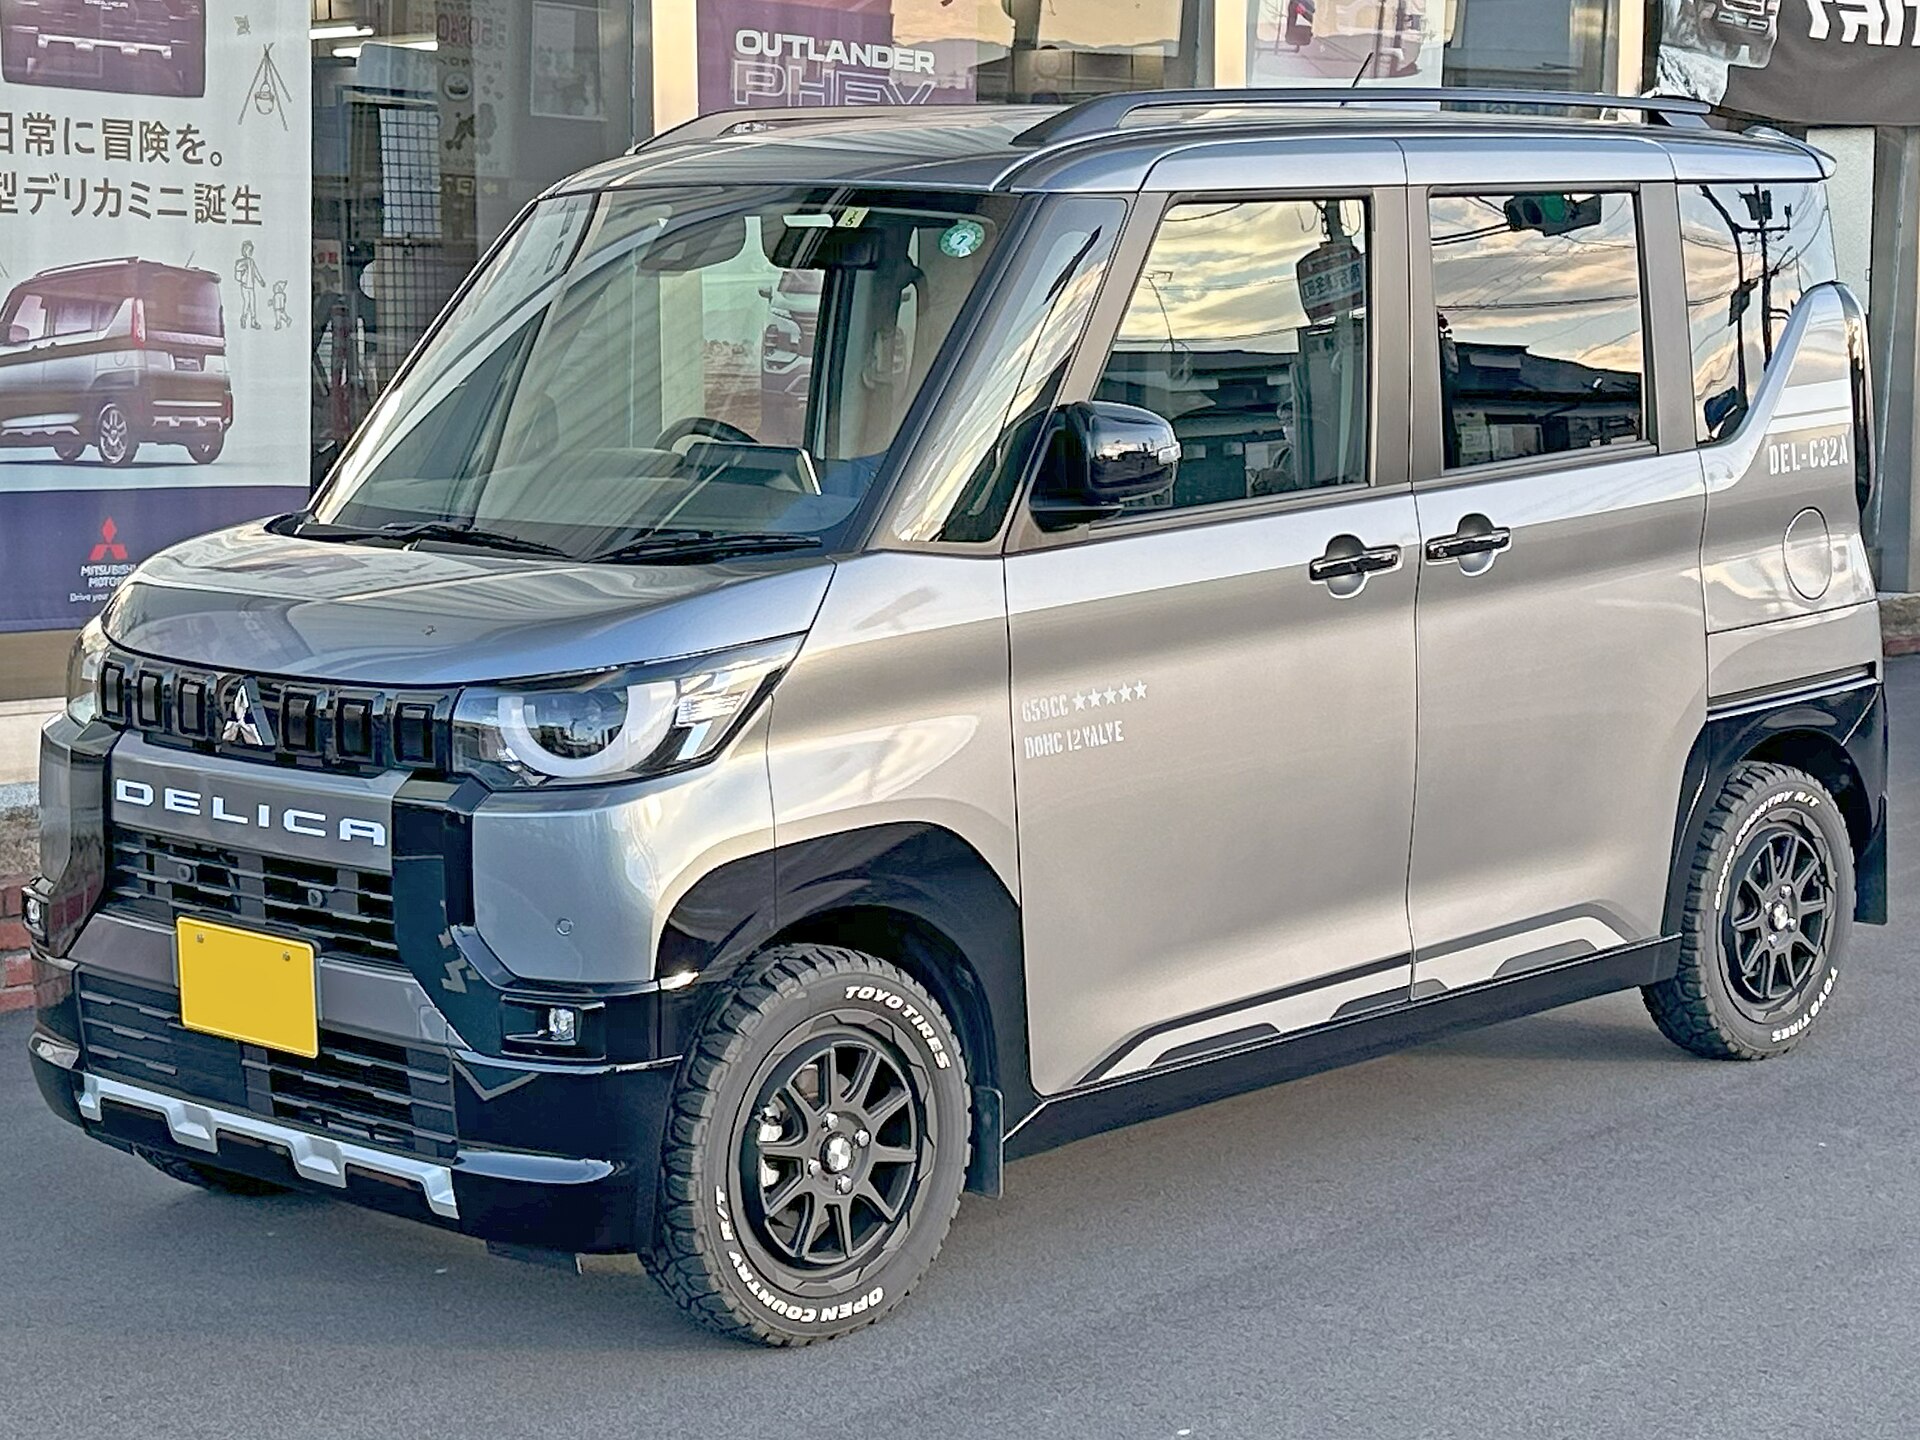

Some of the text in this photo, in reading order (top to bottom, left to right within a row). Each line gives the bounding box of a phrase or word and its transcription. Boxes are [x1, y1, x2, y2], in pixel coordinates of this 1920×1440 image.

[733, 59, 937, 105] PHEV
[735, 29, 935, 74] OUTLANDER
[115, 778, 386, 847] DELICA
[845, 986, 951, 1069] TOYO TIRES
[715, 1185, 884, 1323] OPEN COUNTRY R/T
